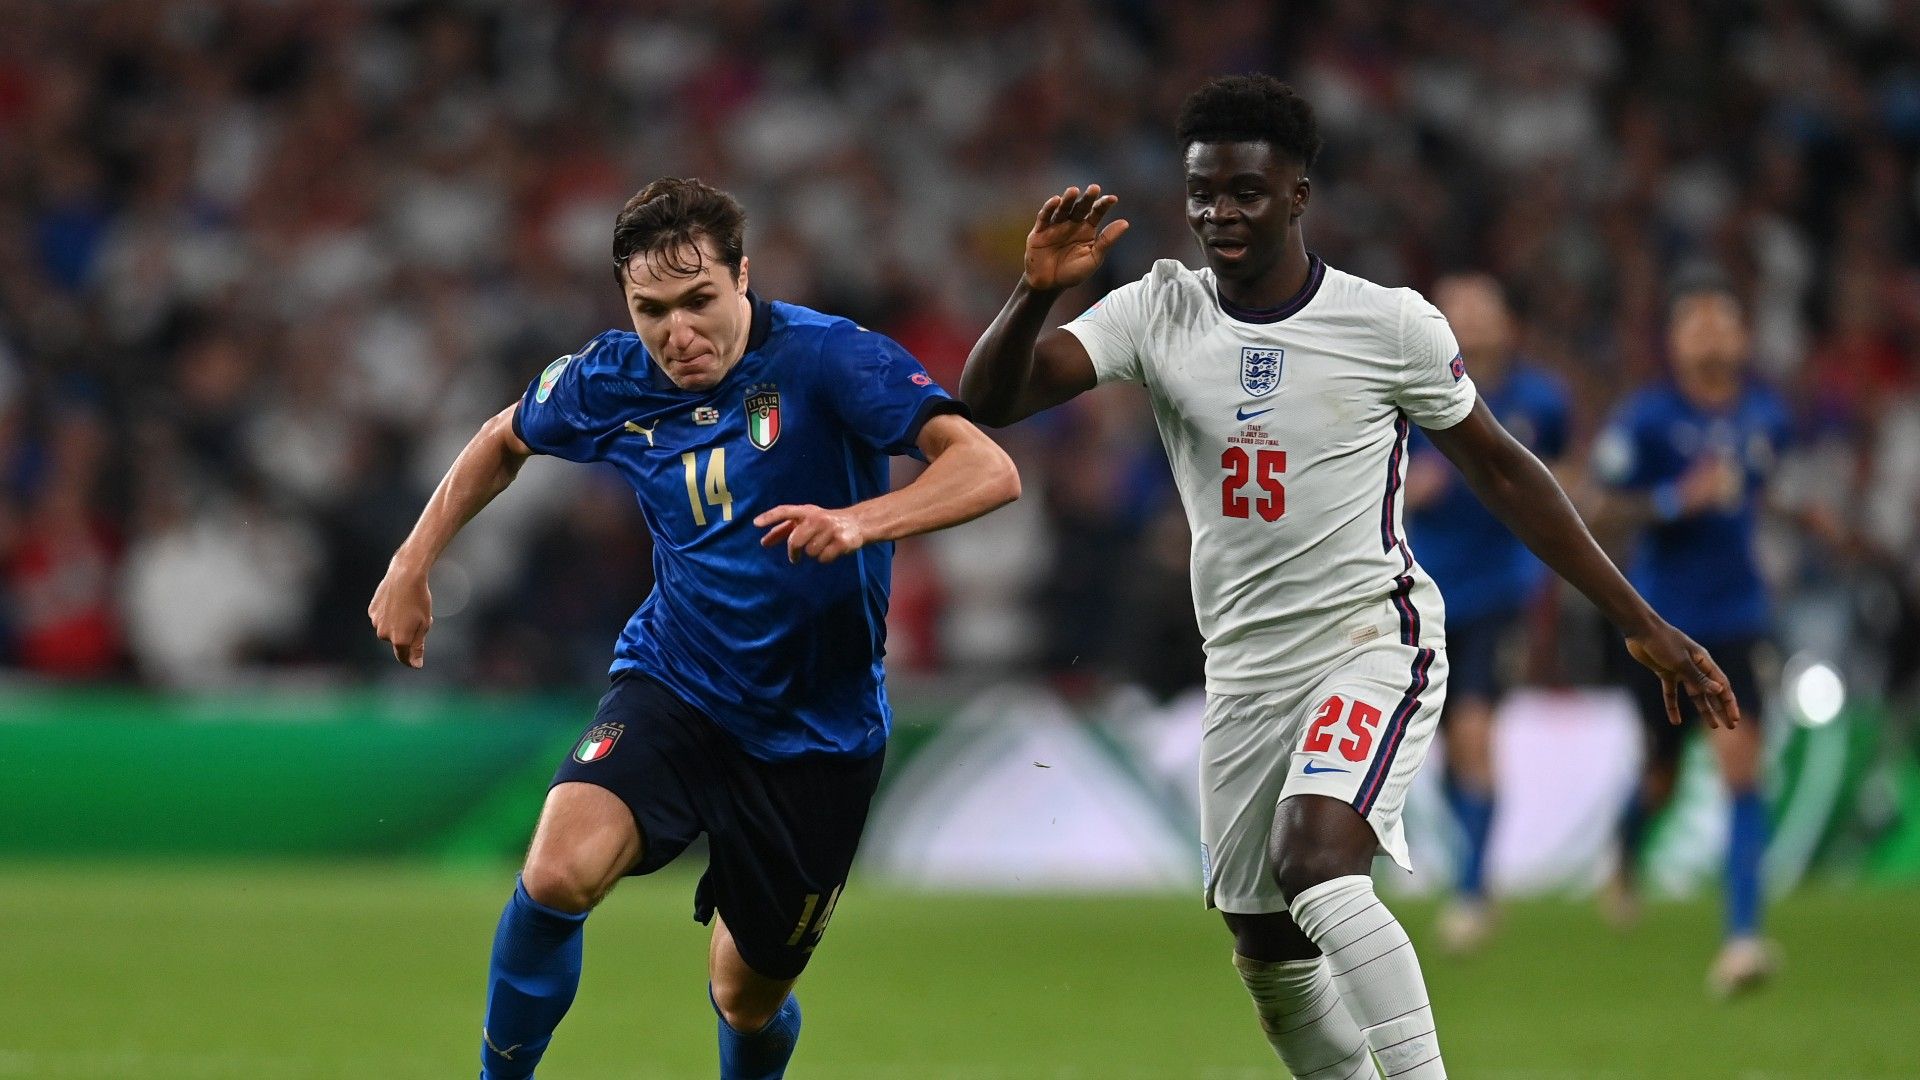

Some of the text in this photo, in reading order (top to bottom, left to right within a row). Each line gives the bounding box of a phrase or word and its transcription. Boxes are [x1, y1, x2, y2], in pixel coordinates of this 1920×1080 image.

[748, 396, 778, 409] ITALIA
[682, 447, 733, 526] 14
[1221, 446, 1287, 522] 25
[1302, 695, 1382, 762] 25
